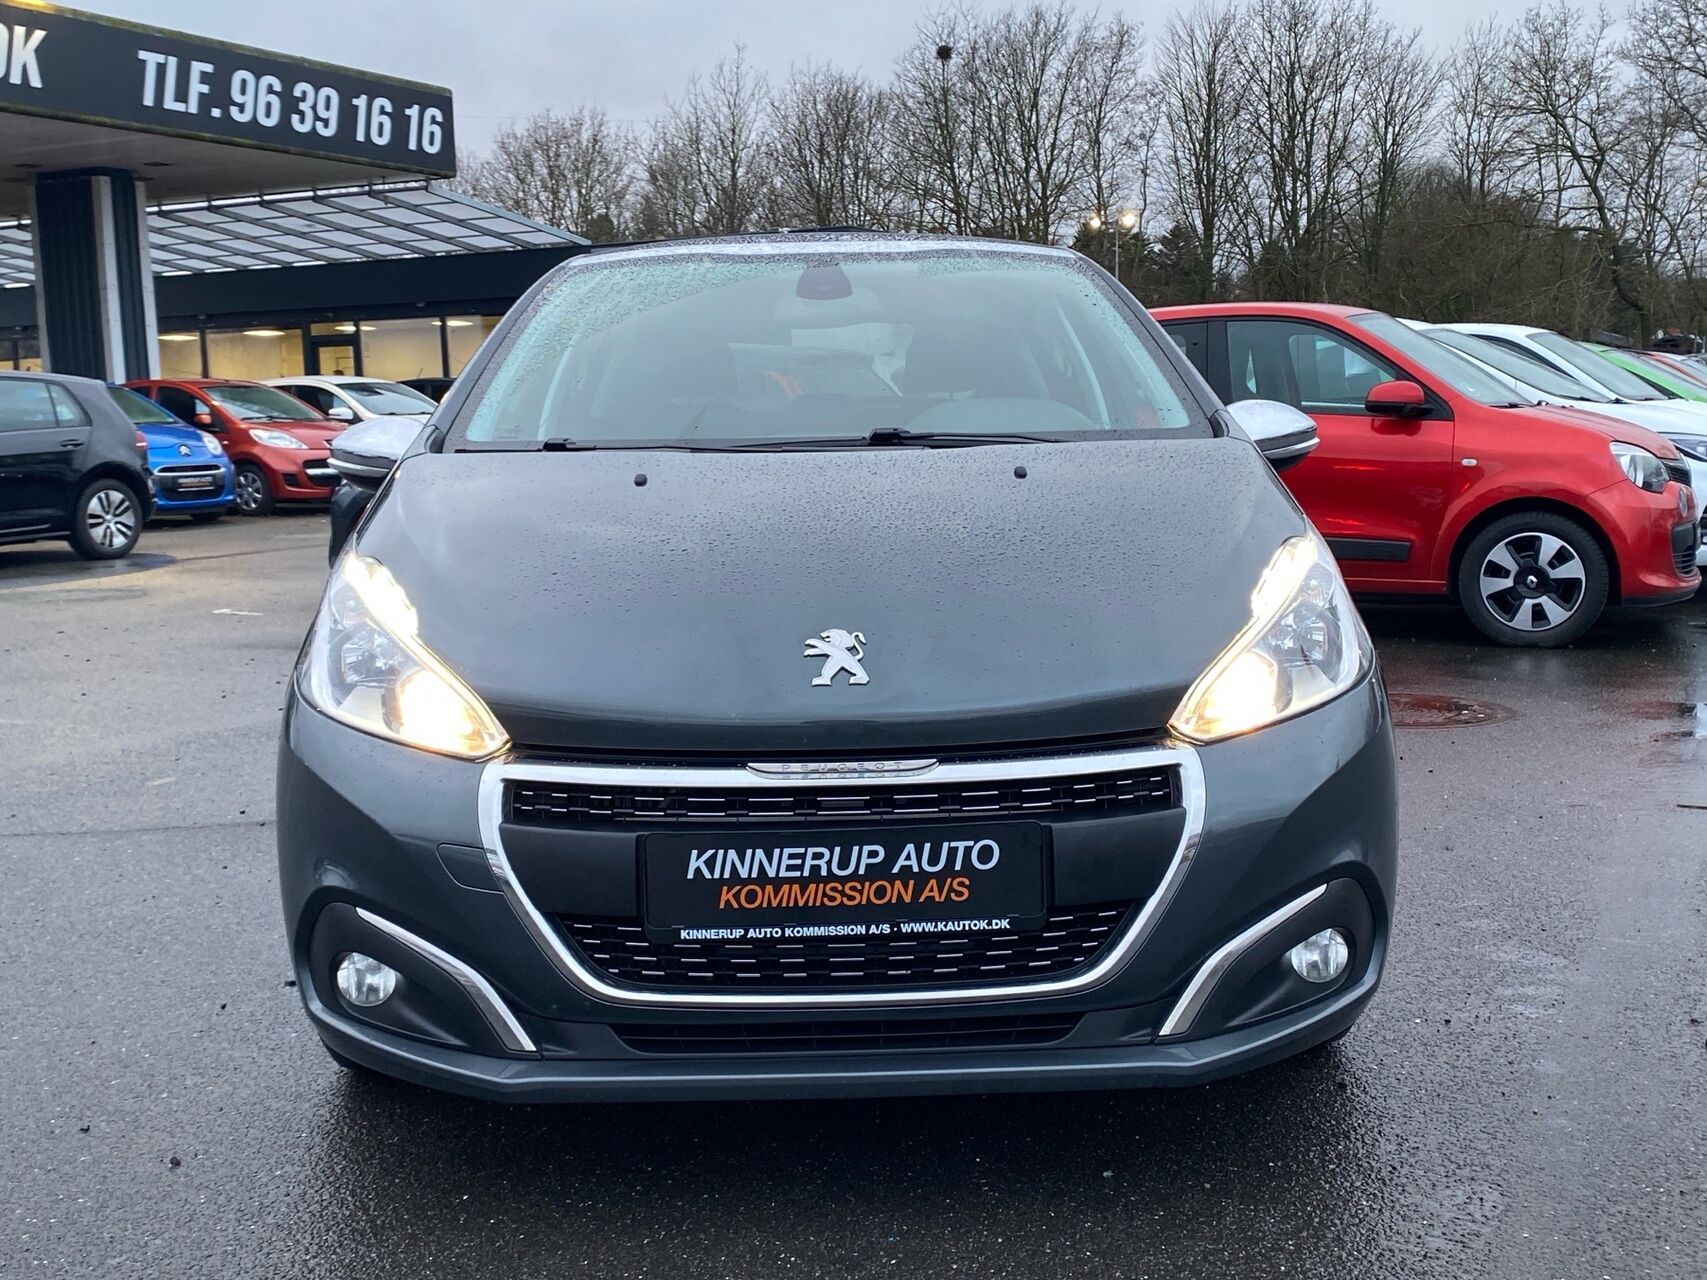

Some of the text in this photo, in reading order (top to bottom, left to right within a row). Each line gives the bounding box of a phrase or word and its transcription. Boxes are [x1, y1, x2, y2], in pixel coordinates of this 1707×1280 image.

[137, 49, 443, 154] TLF. 96 39 16 16
[781, 761, 903, 772] PEUGEOT
[687, 839, 1000, 879] KINNERUP AUTO
[718, 877, 970, 909] KOMMISSION A/S
[680, 929, 745, 939] KINNERUP
[747, 927, 782, 938] AUTO
[785, 924, 866, 937] KOMMISSION
[868, 924, 891, 935] A/S
[900, 919, 1011, 933] WWW.KAUTOK.DK
